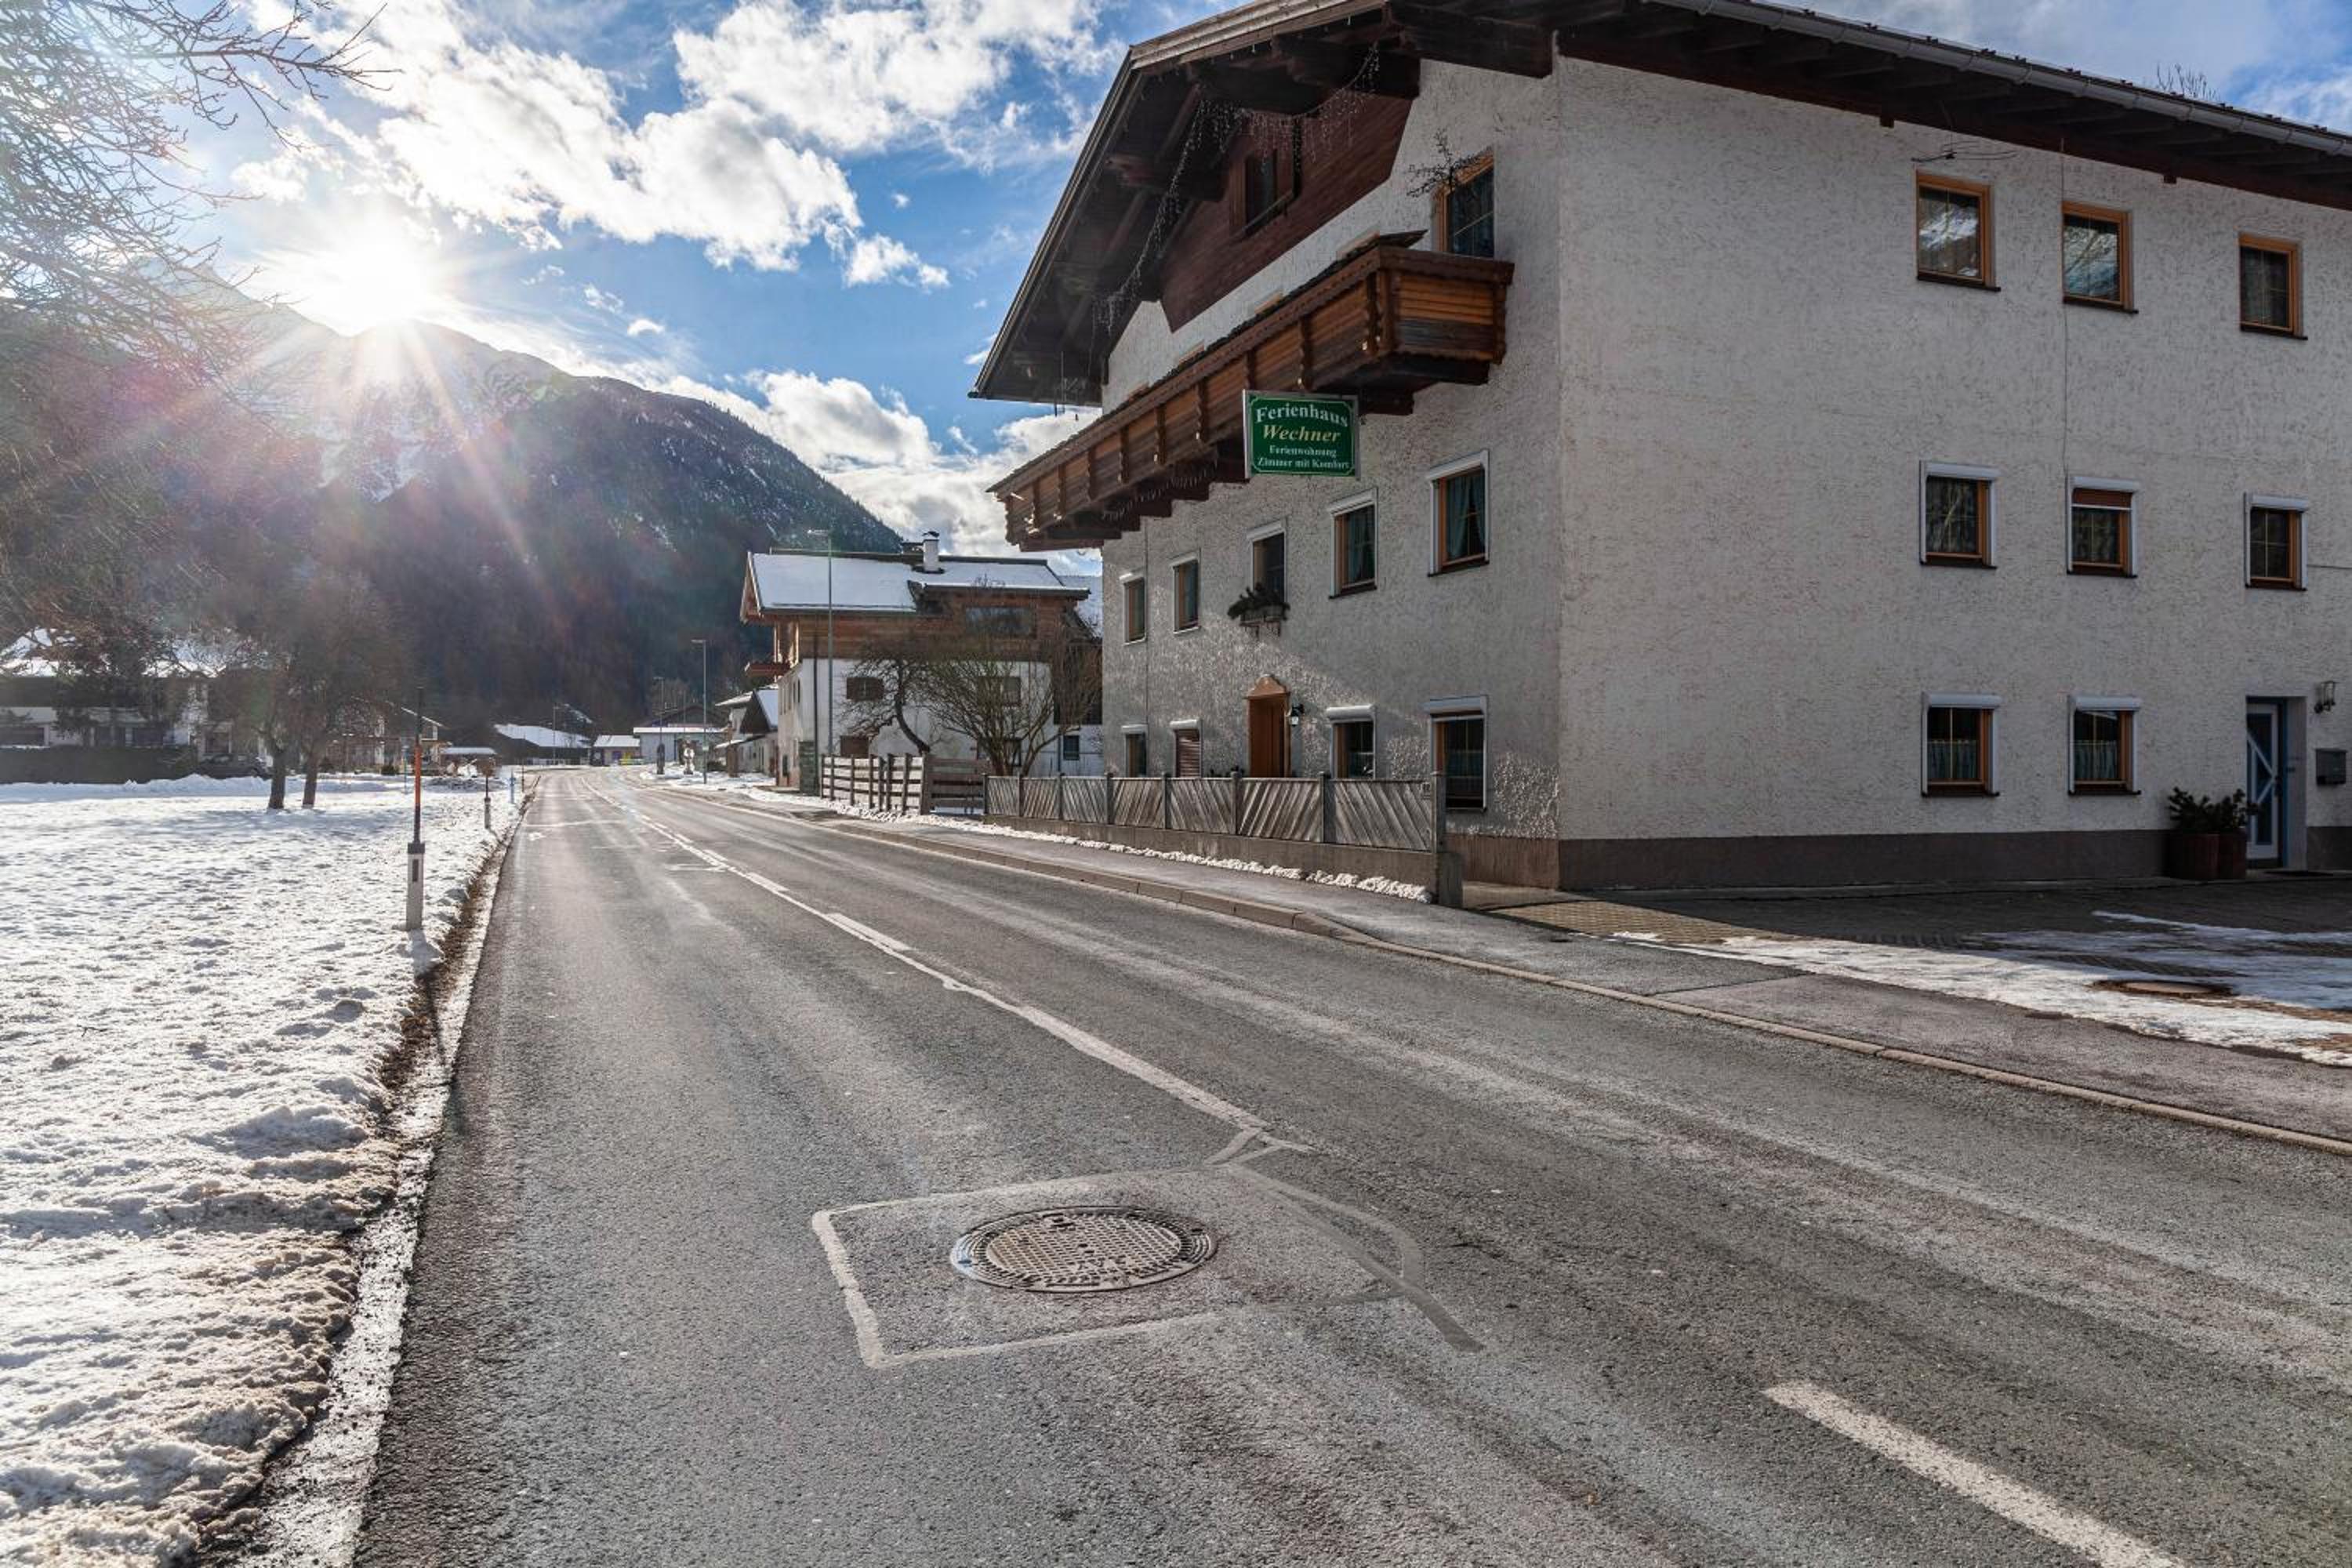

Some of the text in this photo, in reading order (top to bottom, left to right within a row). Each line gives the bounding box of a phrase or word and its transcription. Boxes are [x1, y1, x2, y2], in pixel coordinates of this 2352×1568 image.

[1256, 403, 1348, 426] Ferienhaus
[1263, 424, 1341, 441] Wechner
[1269, 445, 1337, 457] Ferienwohnung
[1258, 457, 1292, 467] Zimmer
[1295, 459, 1310, 468] mit
